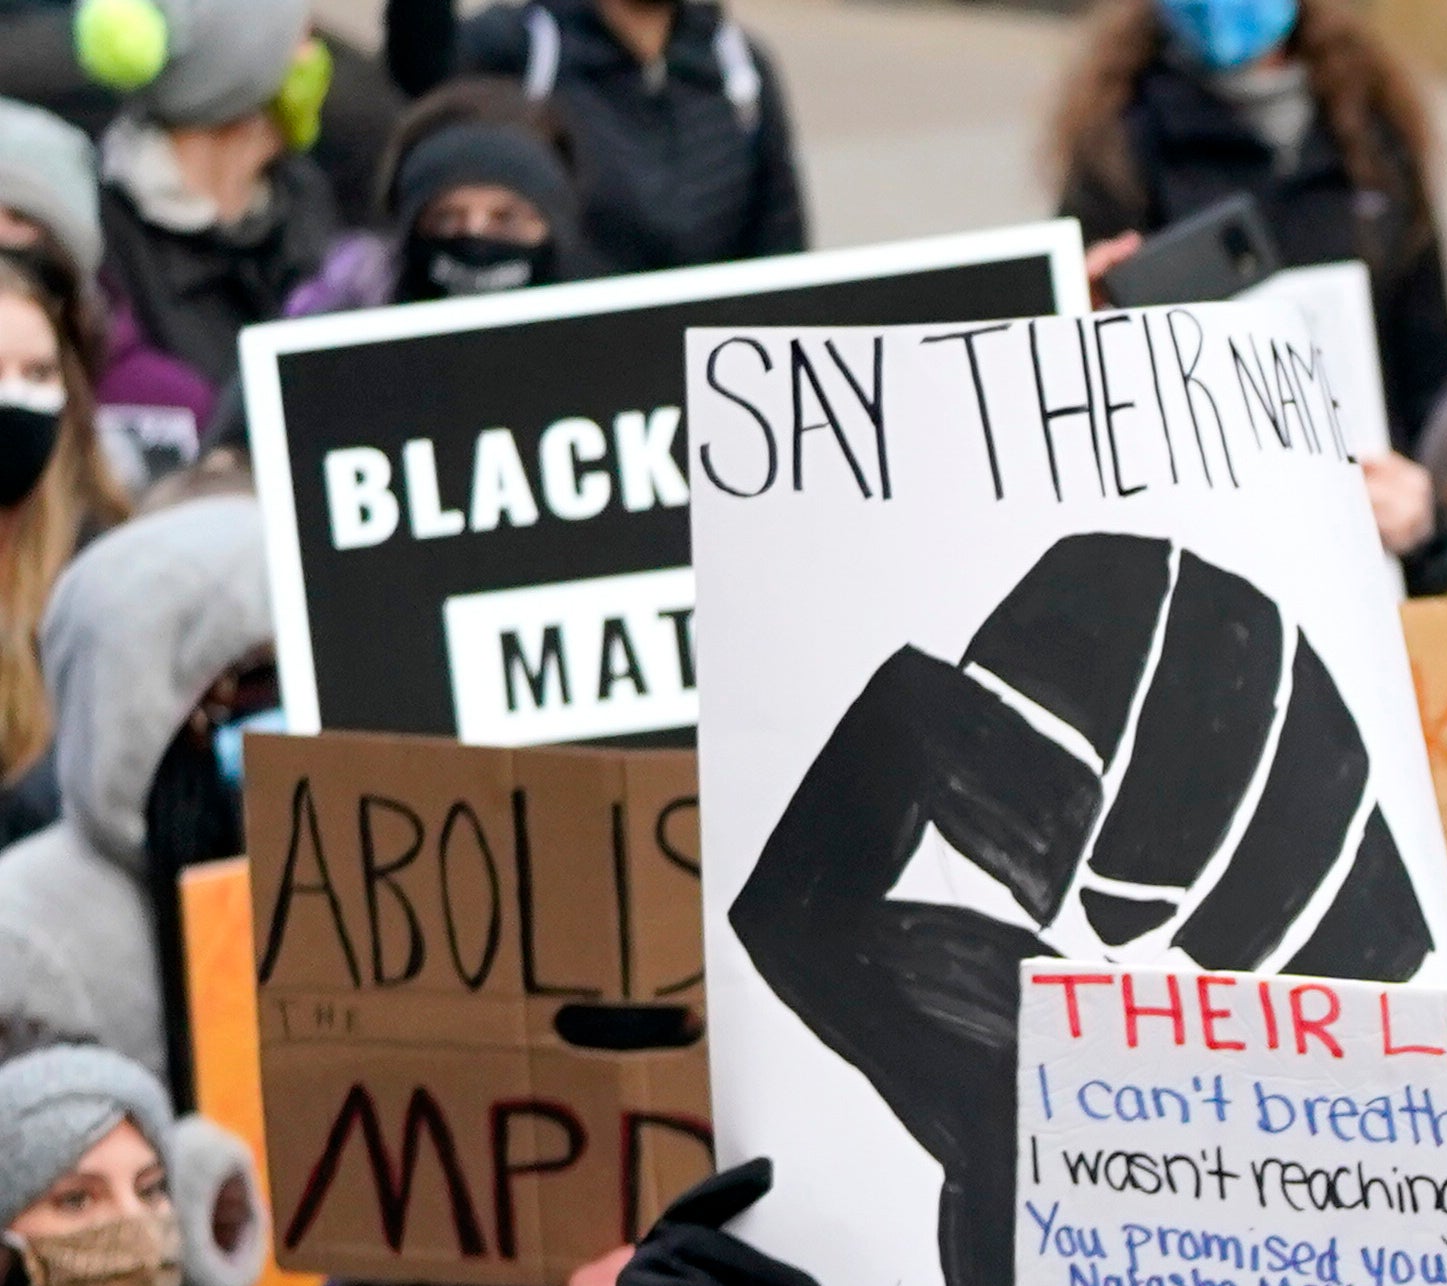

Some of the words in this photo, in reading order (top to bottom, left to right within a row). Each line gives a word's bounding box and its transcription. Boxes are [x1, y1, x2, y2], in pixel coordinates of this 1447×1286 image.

[700, 334, 893, 500] SAY
[920, 315, 1240, 502] THEIR
[322, 404, 691, 550] BLACK
[1031, 973, 1344, 1060] THEIR
[1038, 1064, 1053, 1120] I
[1077, 1075, 1232, 1124] can't
[284, 1082, 717, 1263] MPD
[1030, 1135, 1041, 1185] I
[1062, 1145, 1240, 1201] wasn't
[1025, 1200, 1108, 1259] You
[1122, 1224, 1347, 1285] promised
